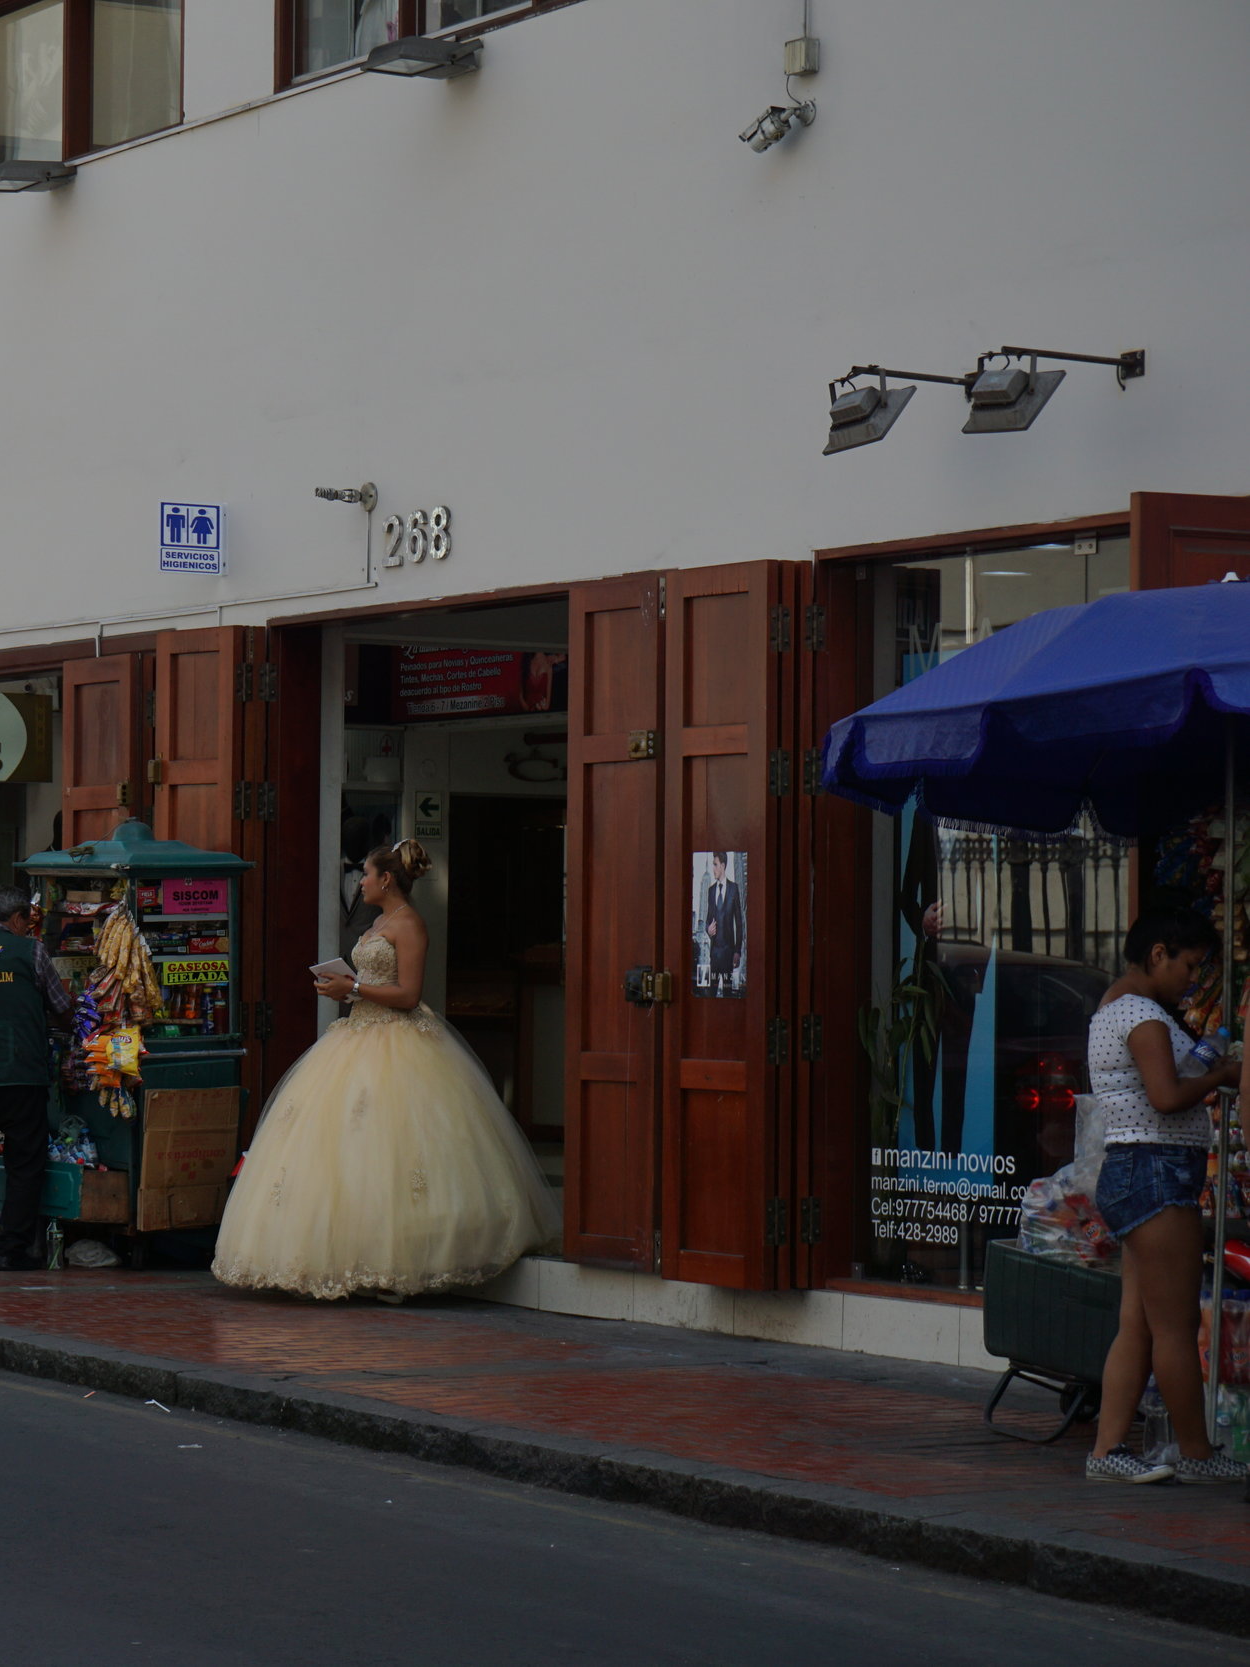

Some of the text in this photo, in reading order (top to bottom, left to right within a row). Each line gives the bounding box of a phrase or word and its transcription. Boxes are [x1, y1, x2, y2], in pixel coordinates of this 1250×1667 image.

[382, 506, 451, 568] 268
[165, 551, 215, 562] SERVICIOS
[162, 560, 218, 571] HIGIENICOS
[429, 660, 442, 670] para
[443, 658, 464, 668] Novias
[469, 653, 514, 666] Quinceañeras
[446, 670, 467, 680] Cortes
[468, 669, 477, 677] de
[477, 666, 502, 677] Cabello
[432, 685, 438, 694] al
[439, 684, 452, 694] tipo
[452, 683, 461, 692] de
[461, 681, 482, 692] Rostro
[407, 702, 430, 714] Tienda
[416, 826, 440, 836] SALIDA
[172, 889, 219, 901] SISCOM
[167, 961, 228, 973] GASEOSA
[168, 971, 228, 983] HELADA
[884, 1148, 951, 1170] manzini
[957, 1153, 1016, 1175] novios
[871, 1219, 959, 1245] Telf:428-2989
